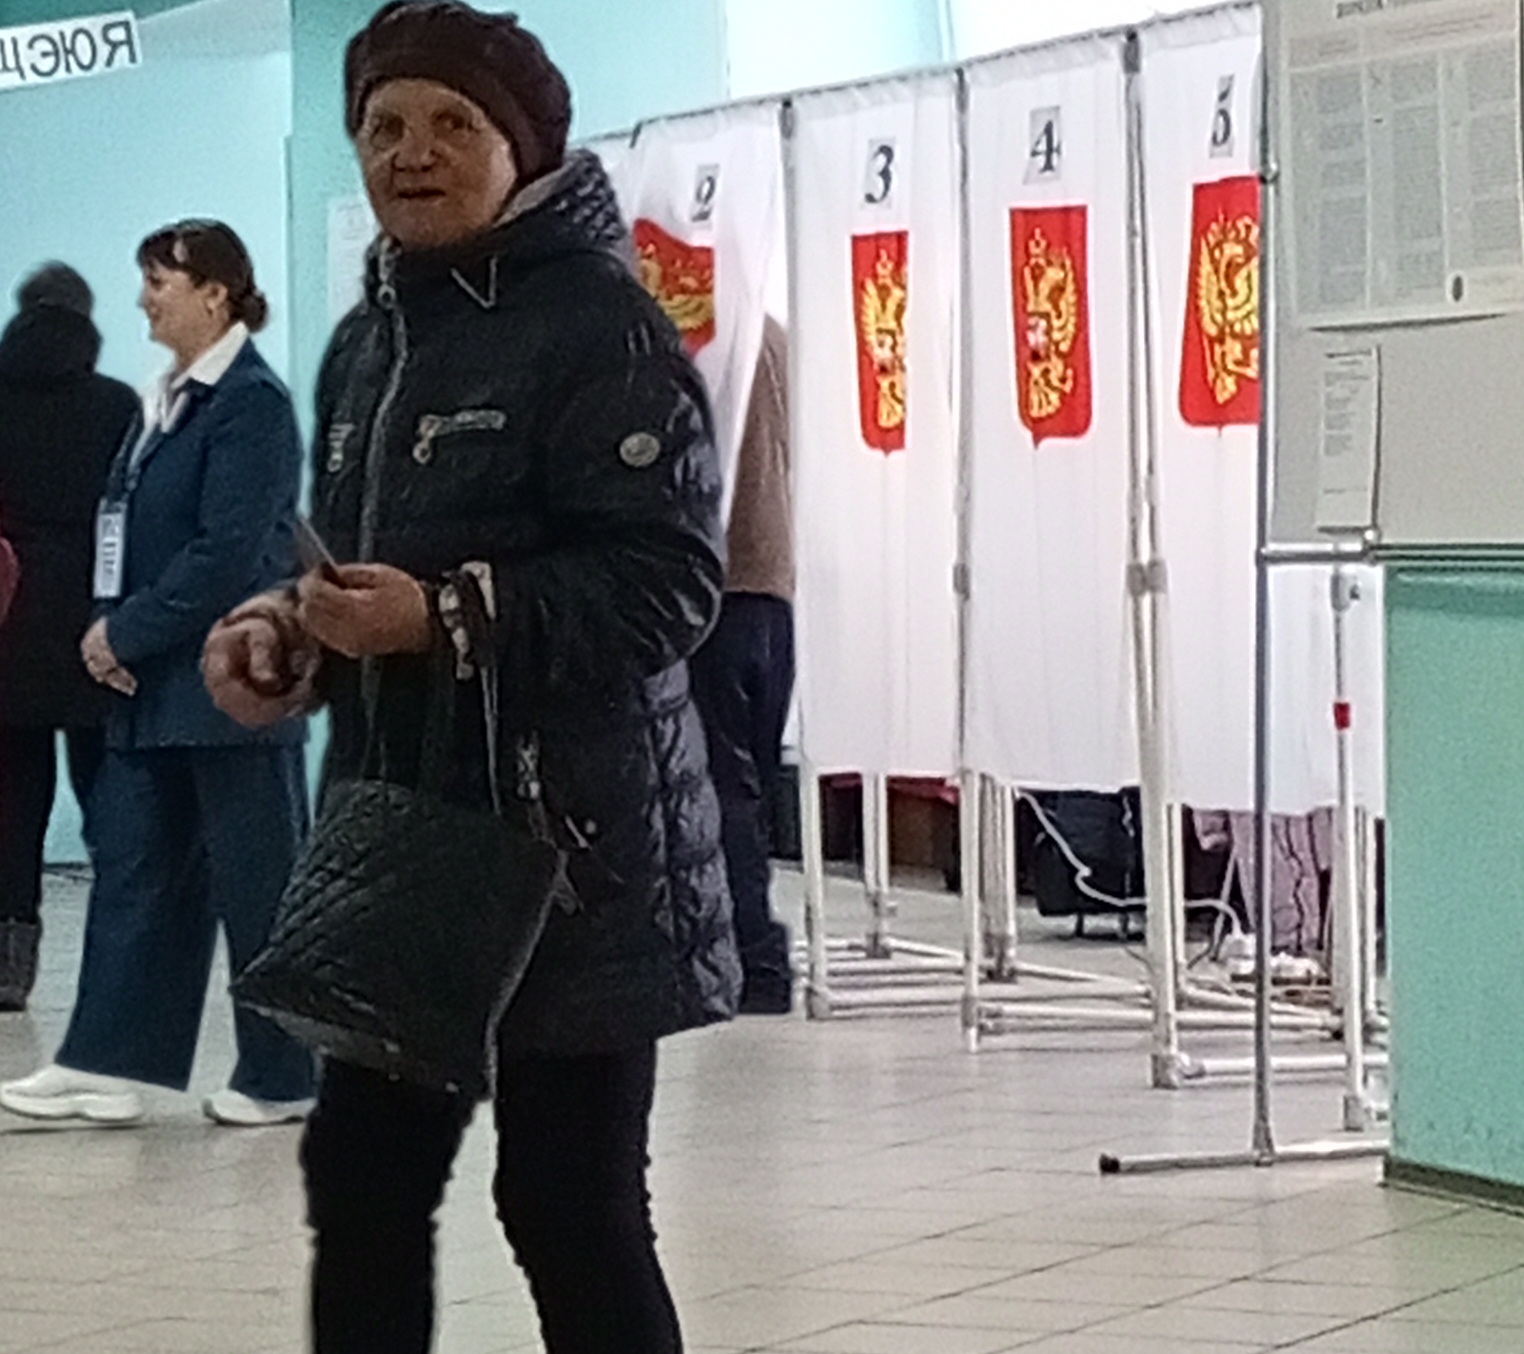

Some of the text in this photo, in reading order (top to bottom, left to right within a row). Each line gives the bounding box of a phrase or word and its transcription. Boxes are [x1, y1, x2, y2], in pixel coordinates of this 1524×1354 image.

[864, 144, 894, 204] 3
[1030, 120, 1061, 174] 4
[691, 176, 716, 222] 2
